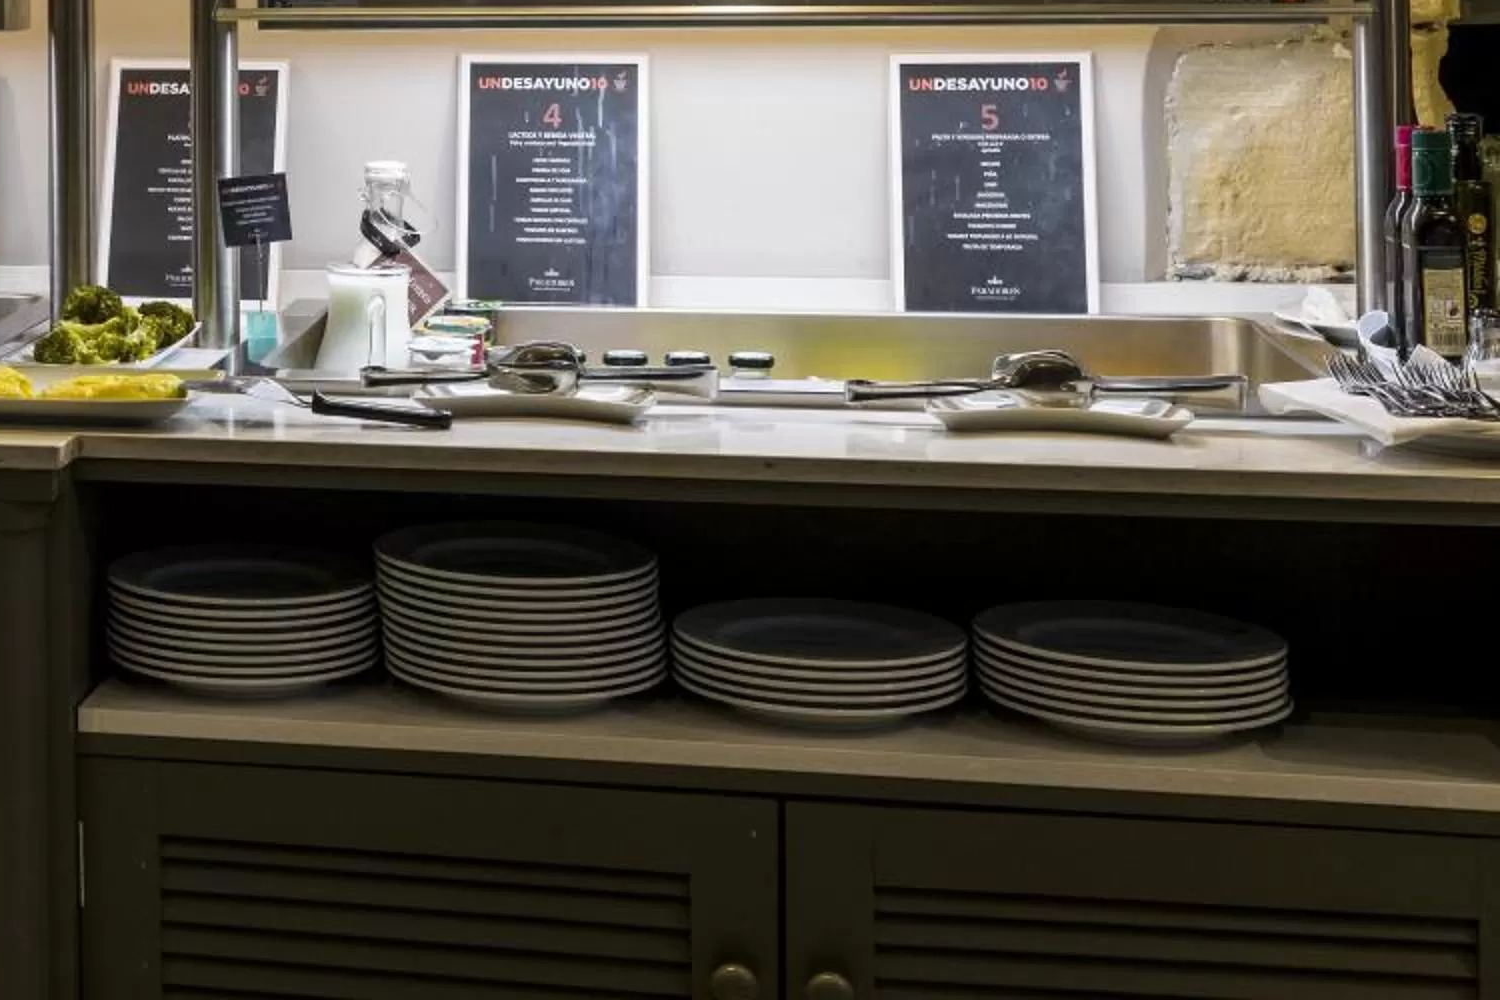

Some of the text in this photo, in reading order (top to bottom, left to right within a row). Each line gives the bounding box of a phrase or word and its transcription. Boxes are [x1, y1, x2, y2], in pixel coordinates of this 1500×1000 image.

[479, 77, 609, 90] UNDESAYUNO10
[909, 77, 1049, 91] UNDESAYUNO10
[542, 103, 562, 128] 4
[981, 104, 999, 131] 5
